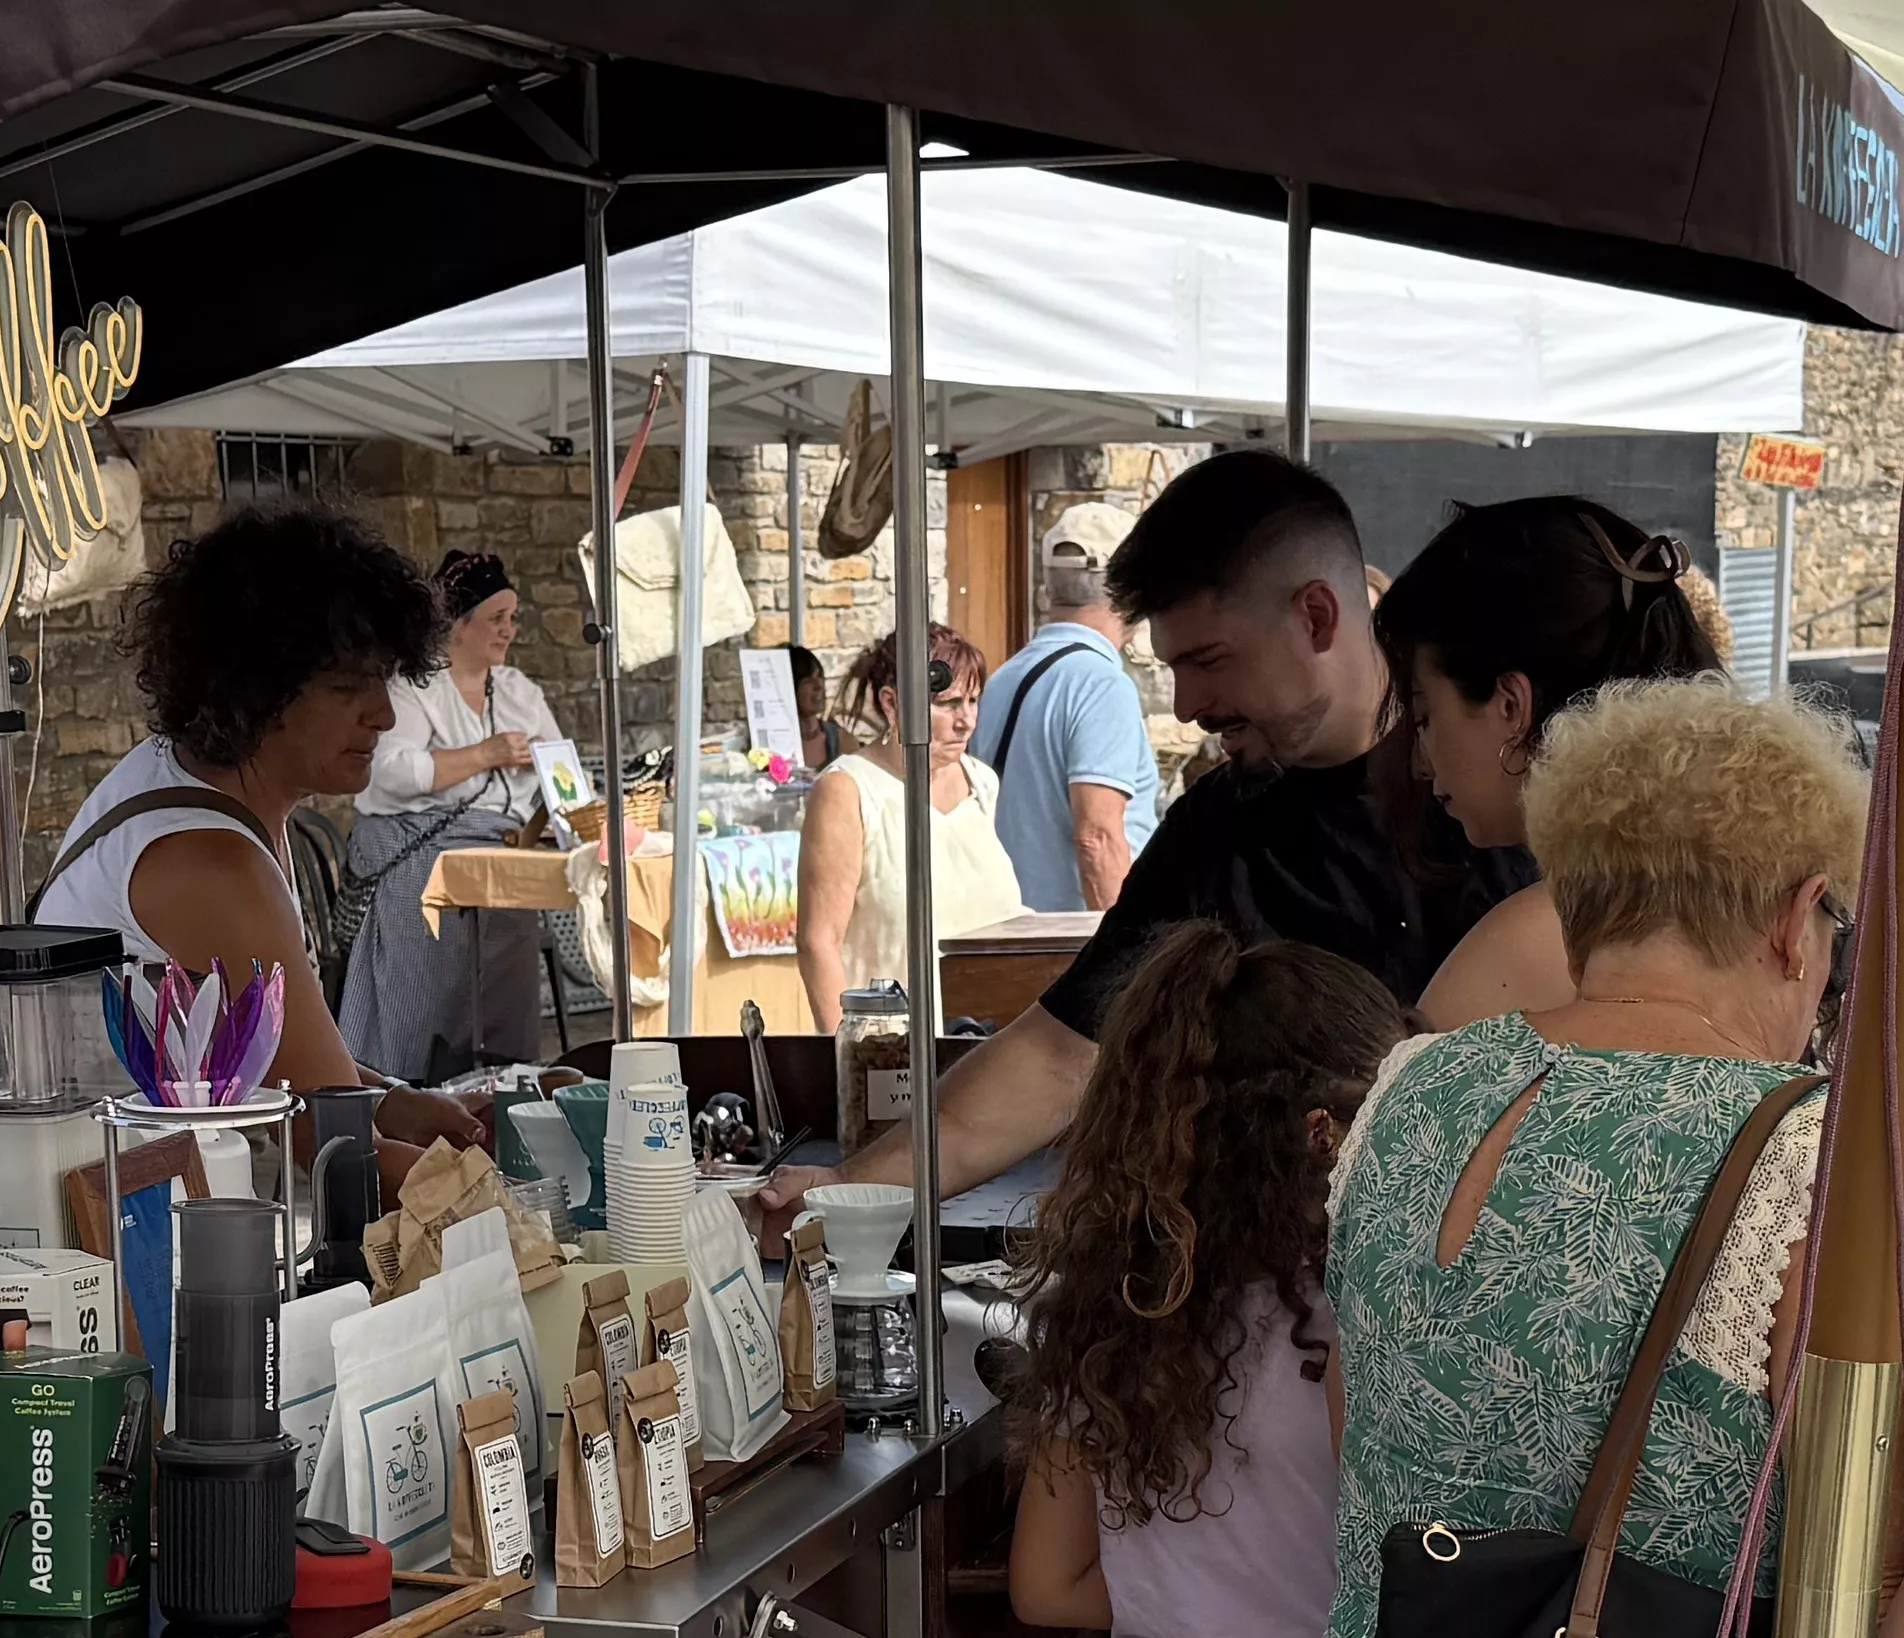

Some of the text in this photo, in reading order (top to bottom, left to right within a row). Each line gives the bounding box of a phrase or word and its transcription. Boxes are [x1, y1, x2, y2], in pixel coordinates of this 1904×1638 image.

[0, 1285, 29, 1293] coffee
[31, 1384, 56, 1397] GO
[29, 1427, 54, 1594] AeroPress
